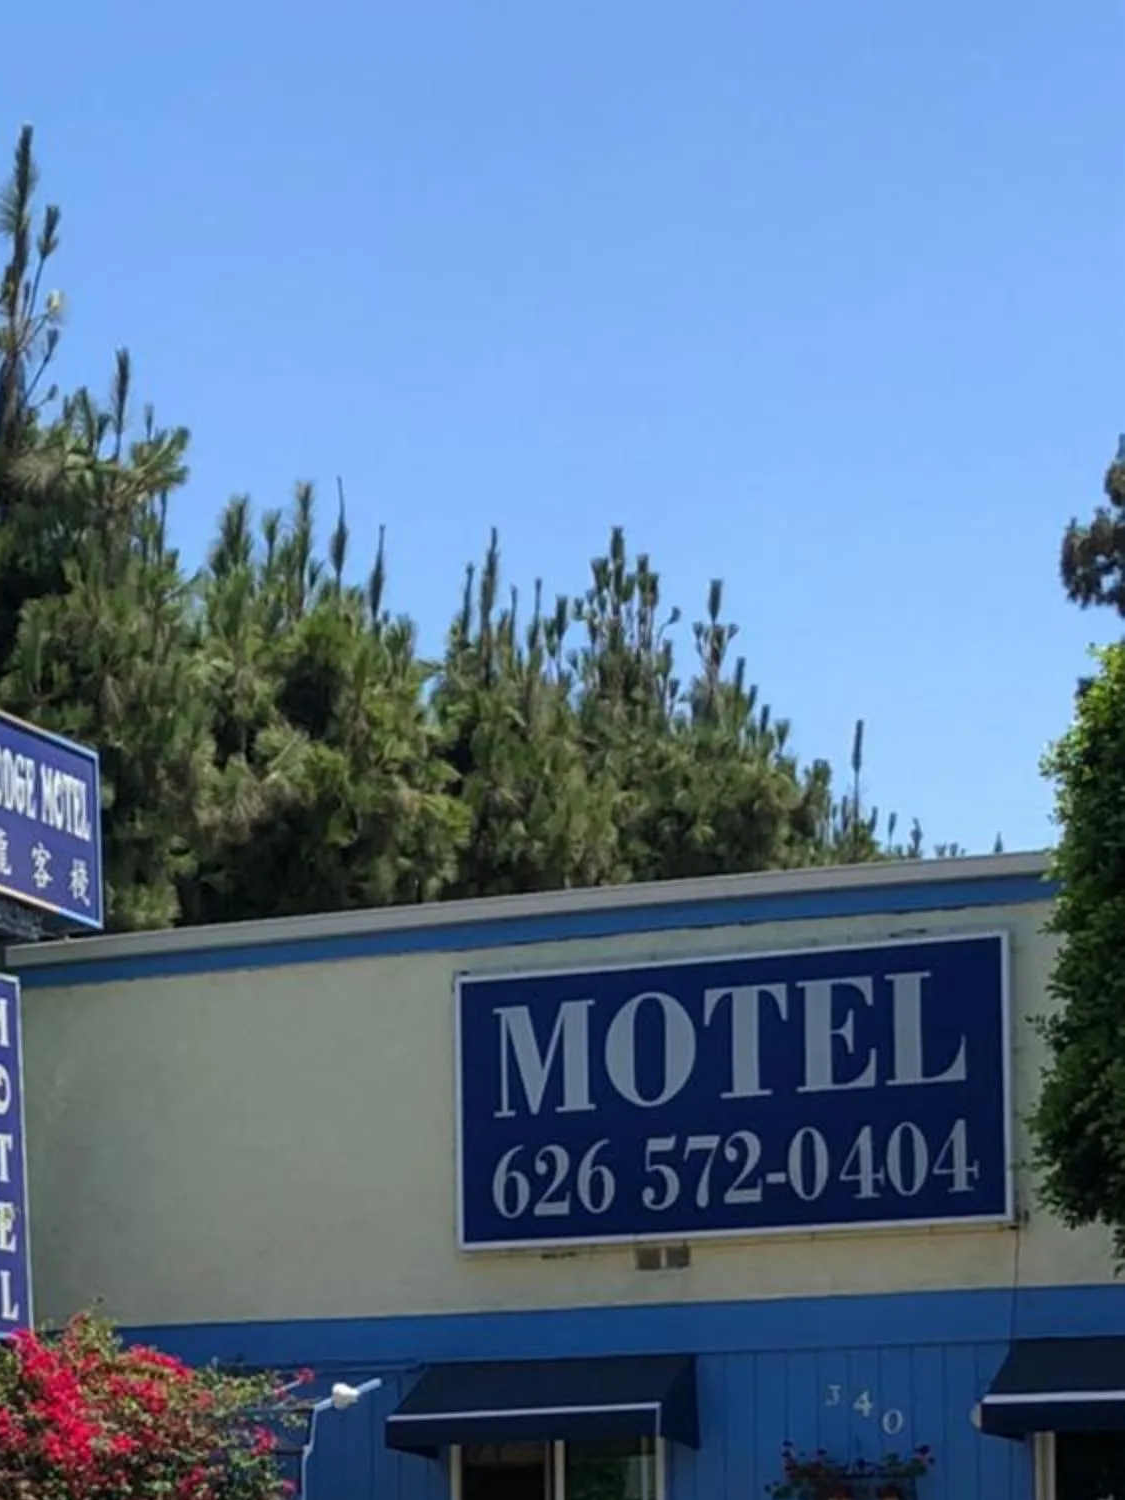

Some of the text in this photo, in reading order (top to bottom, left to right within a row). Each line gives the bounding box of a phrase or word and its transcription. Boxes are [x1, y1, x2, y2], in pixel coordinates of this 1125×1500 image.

[40, 764, 91, 842] MOTEL
[492, 971, 967, 1118] MOTEL
[492, 1118, 979, 1219] 626 572-0404
[826, 1384, 904, 1435] 340
